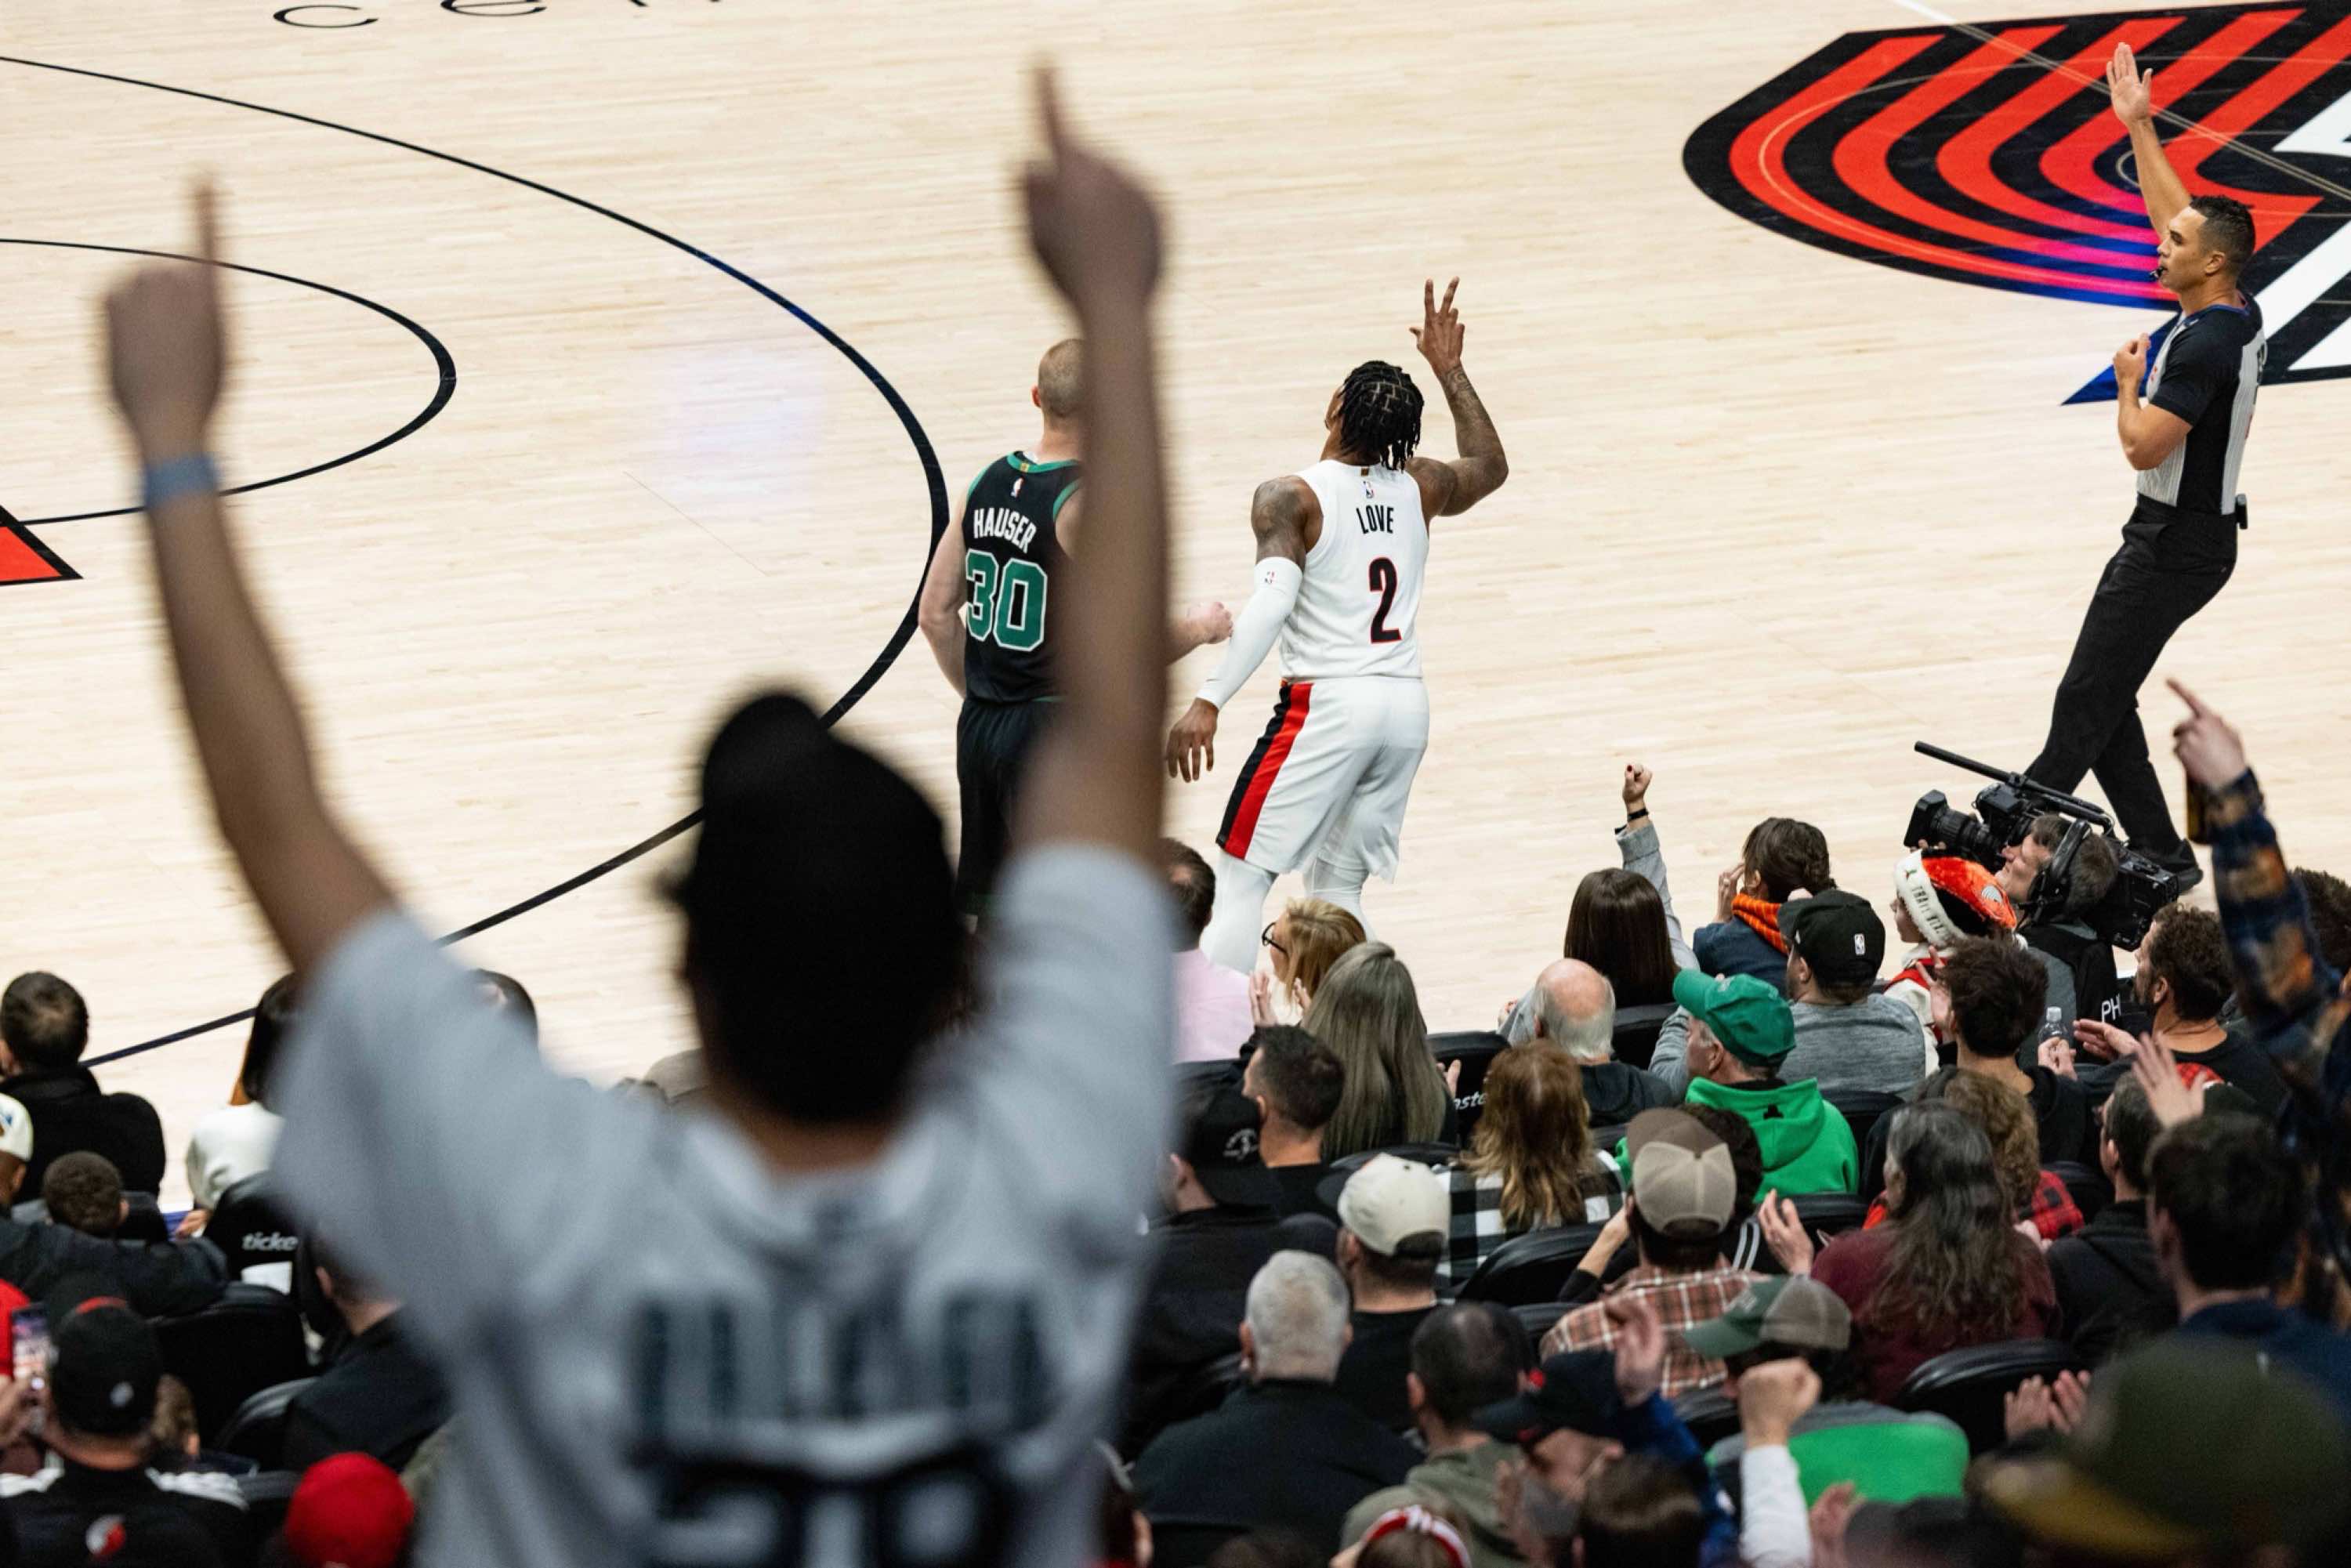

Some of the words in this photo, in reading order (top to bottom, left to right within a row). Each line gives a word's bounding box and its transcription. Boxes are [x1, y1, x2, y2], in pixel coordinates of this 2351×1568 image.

[973, 507, 1037, 554] HAUSER
[1356, 504, 1394, 534] LOVE
[965, 549, 1049, 652] 30
[1368, 556, 1403, 645] 2
